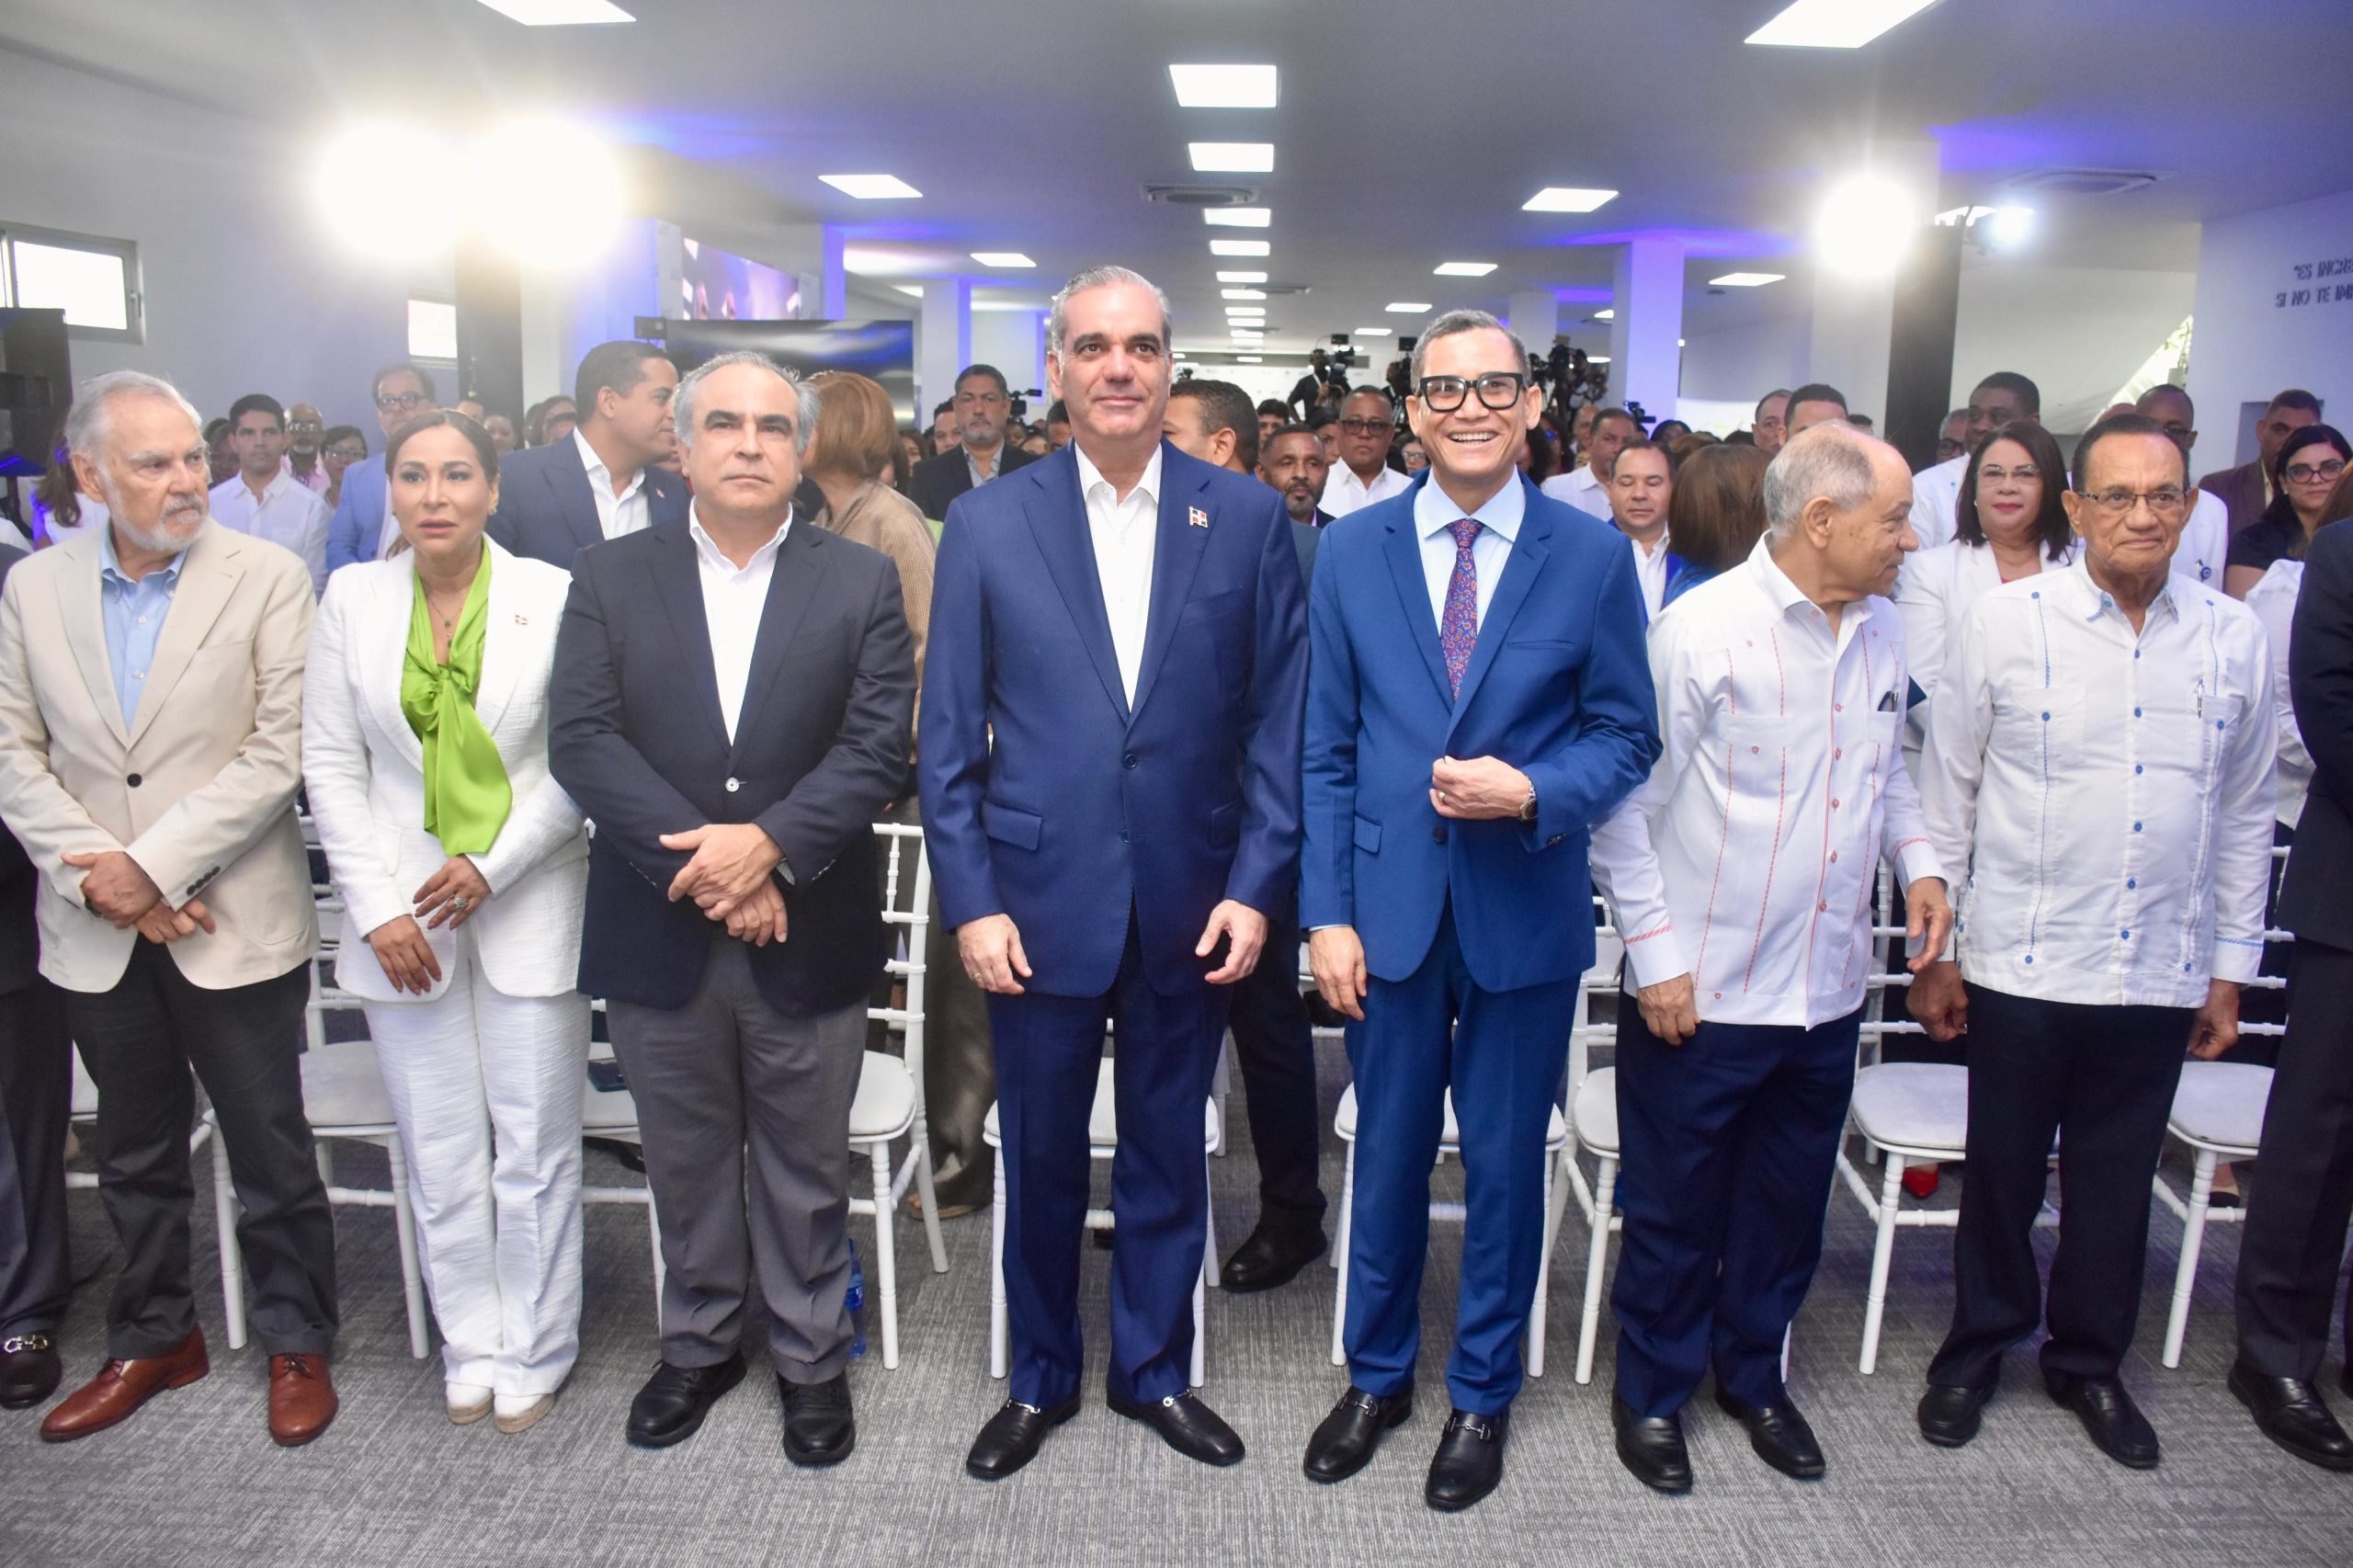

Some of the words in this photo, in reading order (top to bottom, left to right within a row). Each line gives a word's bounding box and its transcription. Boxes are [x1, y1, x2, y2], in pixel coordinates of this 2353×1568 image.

[2275, 291, 2287, 309] SI
[2291, 289, 2311, 306] NO
[2316, 286, 2331, 303] TE
